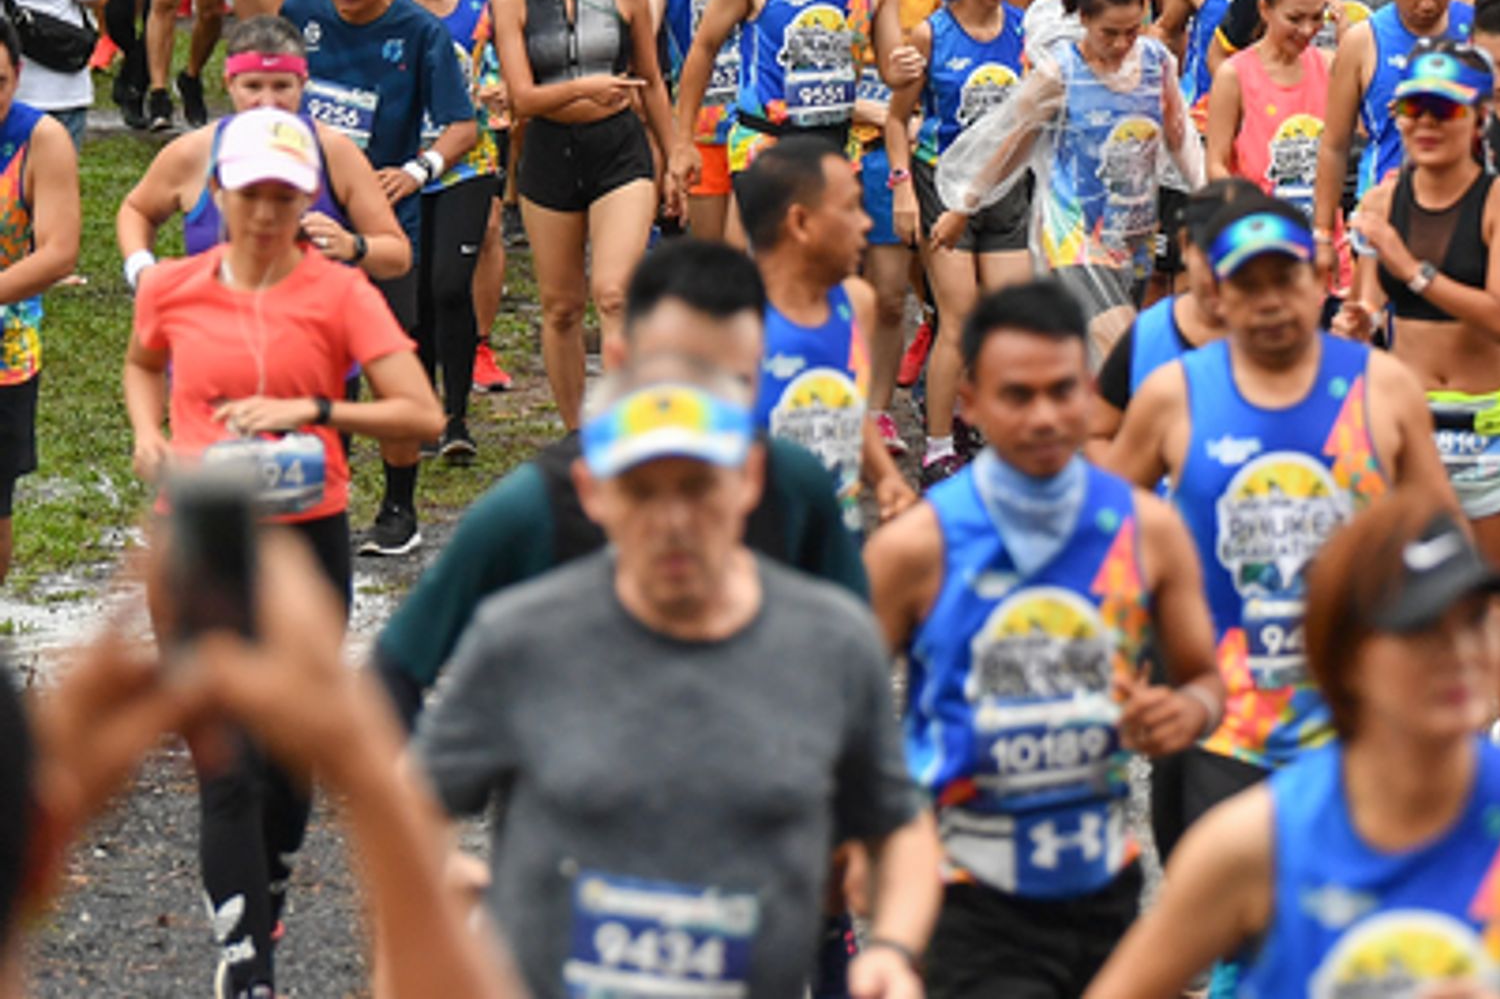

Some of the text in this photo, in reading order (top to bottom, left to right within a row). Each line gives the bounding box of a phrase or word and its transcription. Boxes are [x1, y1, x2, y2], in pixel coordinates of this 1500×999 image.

[307, 98, 360, 128] 9256
[989, 725, 1108, 774] 10189
[593, 921, 727, 982] 9434
